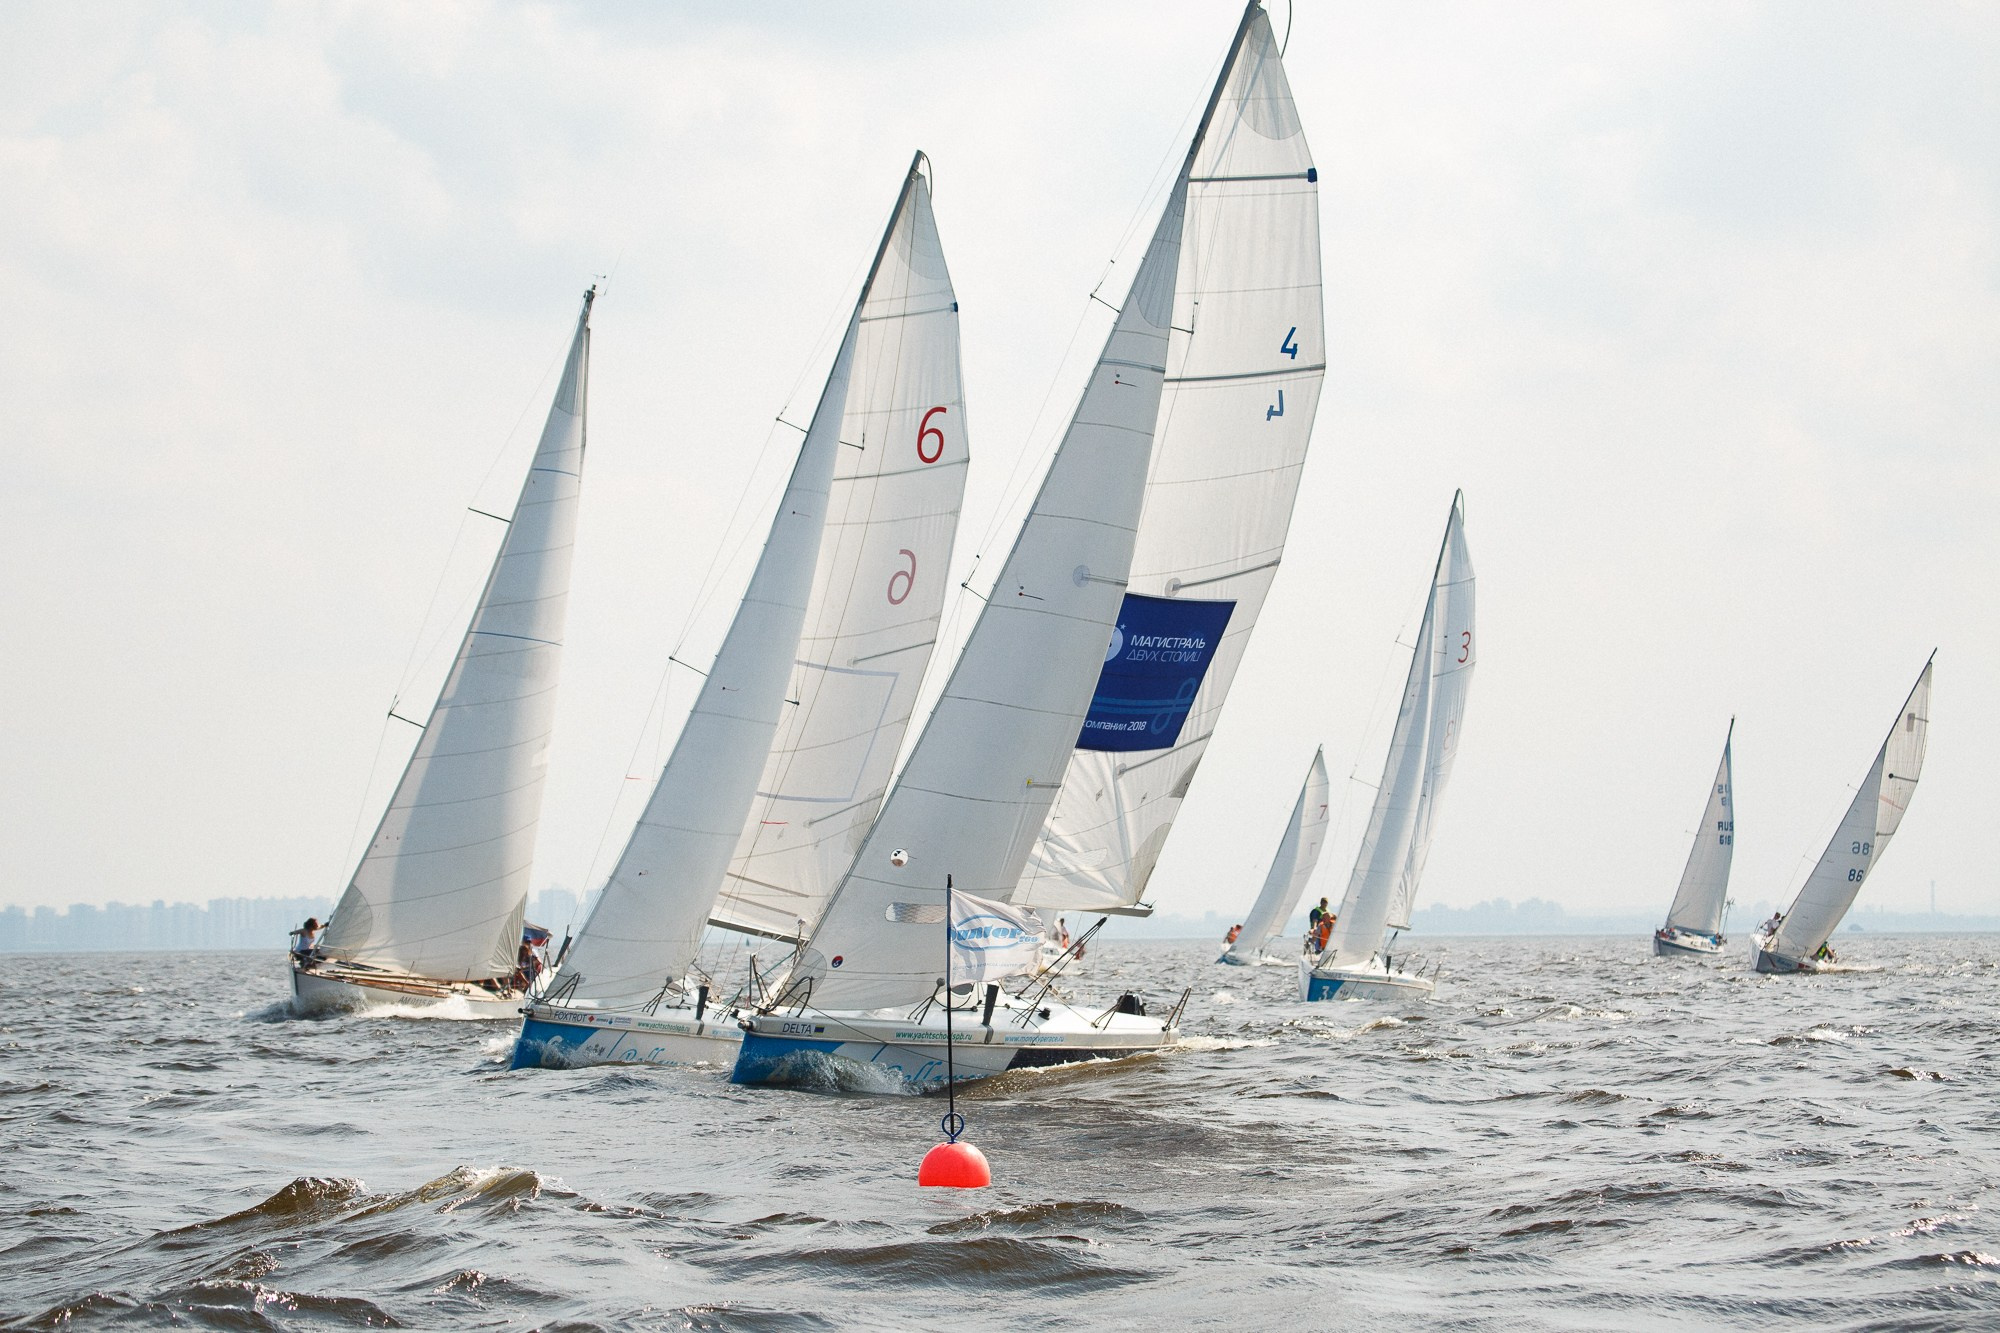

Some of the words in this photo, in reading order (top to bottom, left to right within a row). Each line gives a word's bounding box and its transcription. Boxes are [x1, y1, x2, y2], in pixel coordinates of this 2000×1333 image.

[1280, 327, 1298, 359] 4
[917, 406, 947, 464] 6
[1131, 635, 1206, 649] МАГИСТРАЛЬ
[1457, 631, 1471, 663] 3
[1126, 649, 1158, 662] ДВУХ
[1160, 650, 1201, 662] СТОЛИЦ
[1127, 721, 1147, 731] 2018
[1320, 804, 1328, 820] 7
[1717, 821, 1734, 831] RUS
[1848, 868, 1864, 882] 86
[553, 1010, 588, 1023] FOXTROT
[637, 1021, 691, 1033] www.yachtschoolspb.ru
[782, 1022, 812, 1034] DELTA
[895, 1031, 973, 1042] www.yachtscholspb.ru
